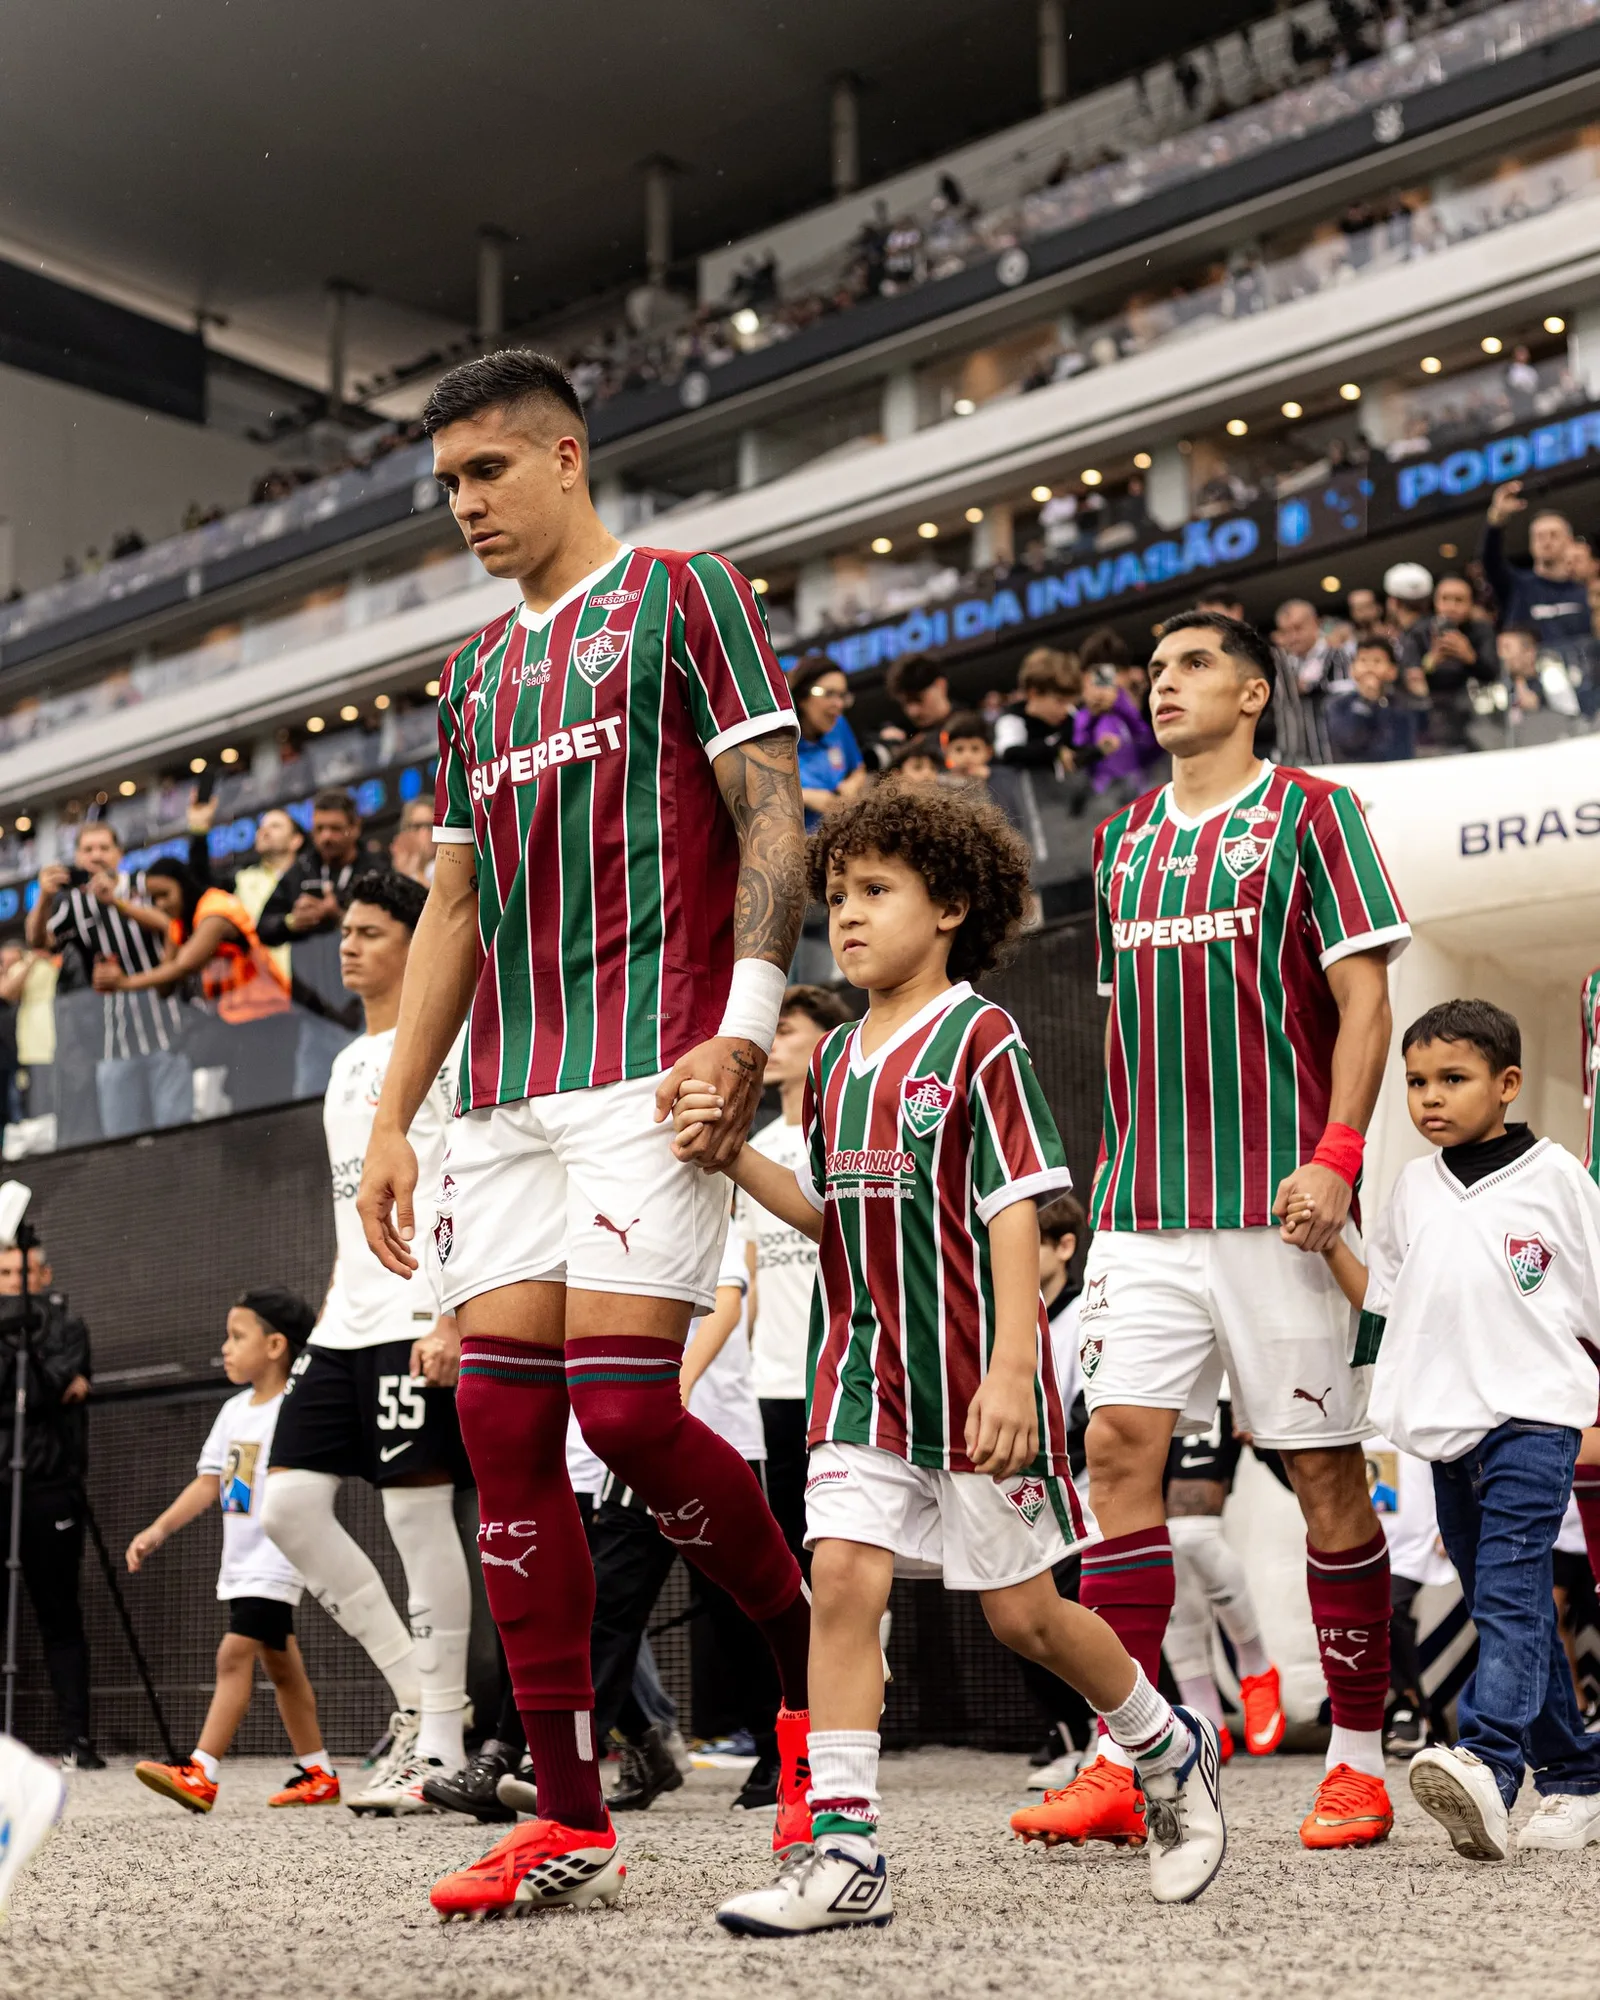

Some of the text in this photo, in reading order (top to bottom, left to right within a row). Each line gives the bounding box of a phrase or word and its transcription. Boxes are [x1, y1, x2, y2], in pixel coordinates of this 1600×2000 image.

[954, 589, 1023, 640] DA
[1026, 518, 1260, 619] INVASÃO
[592, 592, 638, 606] FRESCATTO
[511, 658, 552, 685] Leve
[526, 673, 551, 687] saúde
[472, 715, 623, 802] SUPERBET
[1158, 854, 1199, 872] Leve
[1112, 907, 1257, 949] SUPERBET
[377, 1375, 427, 1430] 55
[476, 1520, 537, 1542] FFC
[1320, 1628, 1369, 1643] FFC
